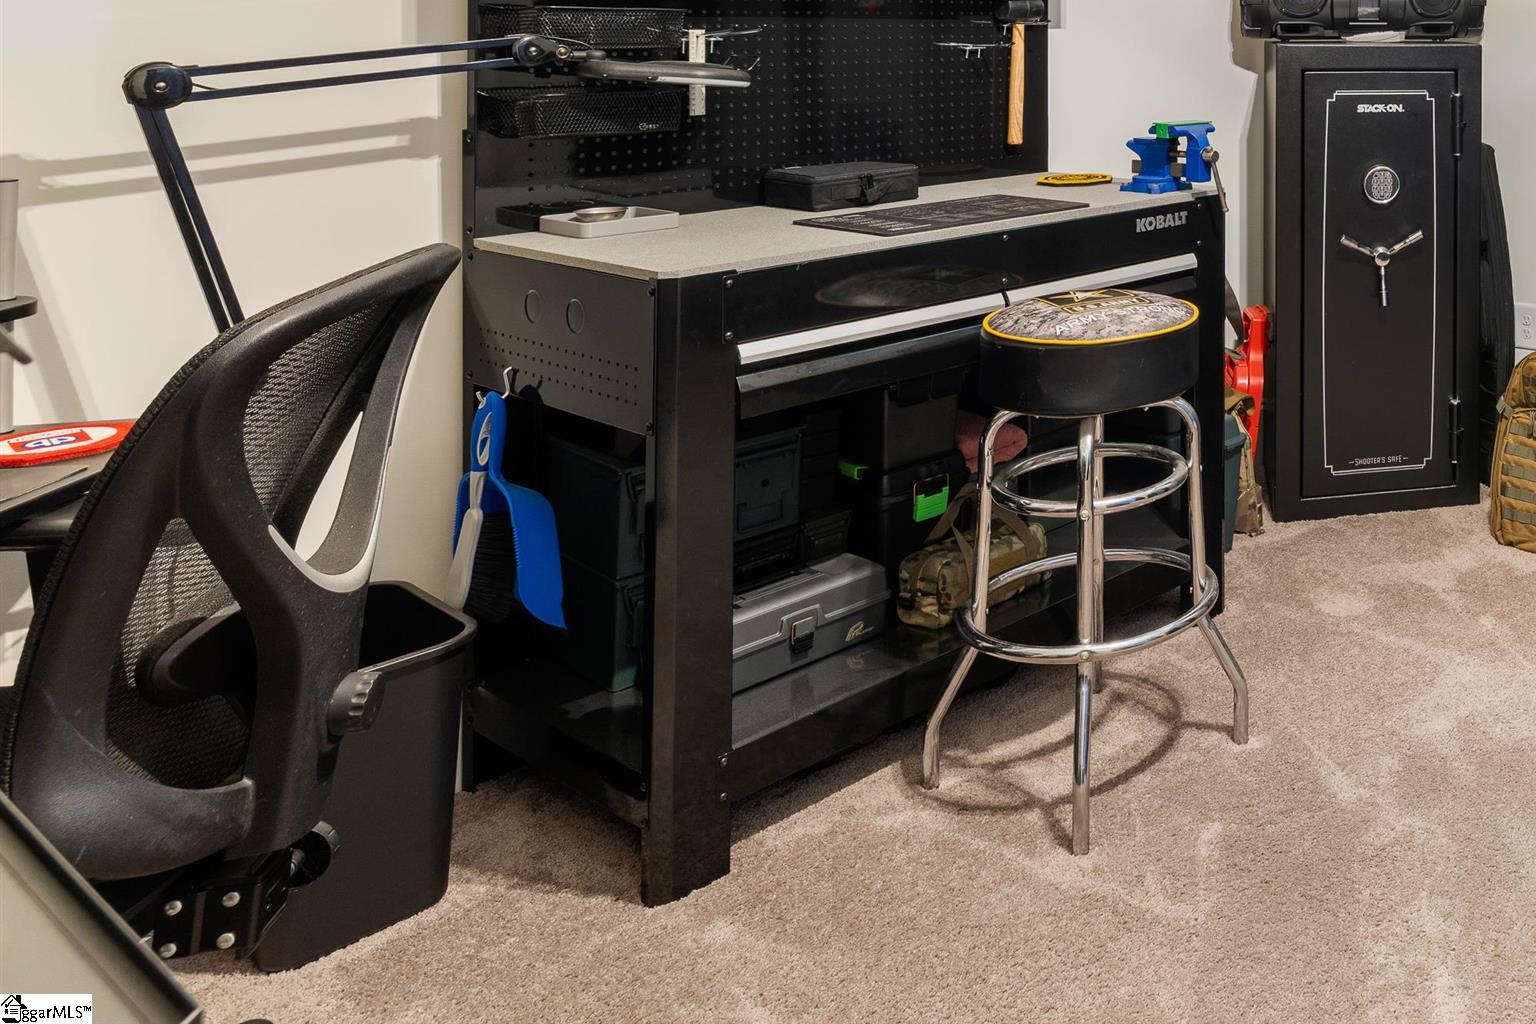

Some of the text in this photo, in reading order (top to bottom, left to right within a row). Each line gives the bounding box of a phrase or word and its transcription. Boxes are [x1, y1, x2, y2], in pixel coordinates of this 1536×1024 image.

[1136, 211, 1188, 233] KOBALT
[1055, 312, 1107, 336] ARMY
[1387, 454, 1402, 463] SAFE
